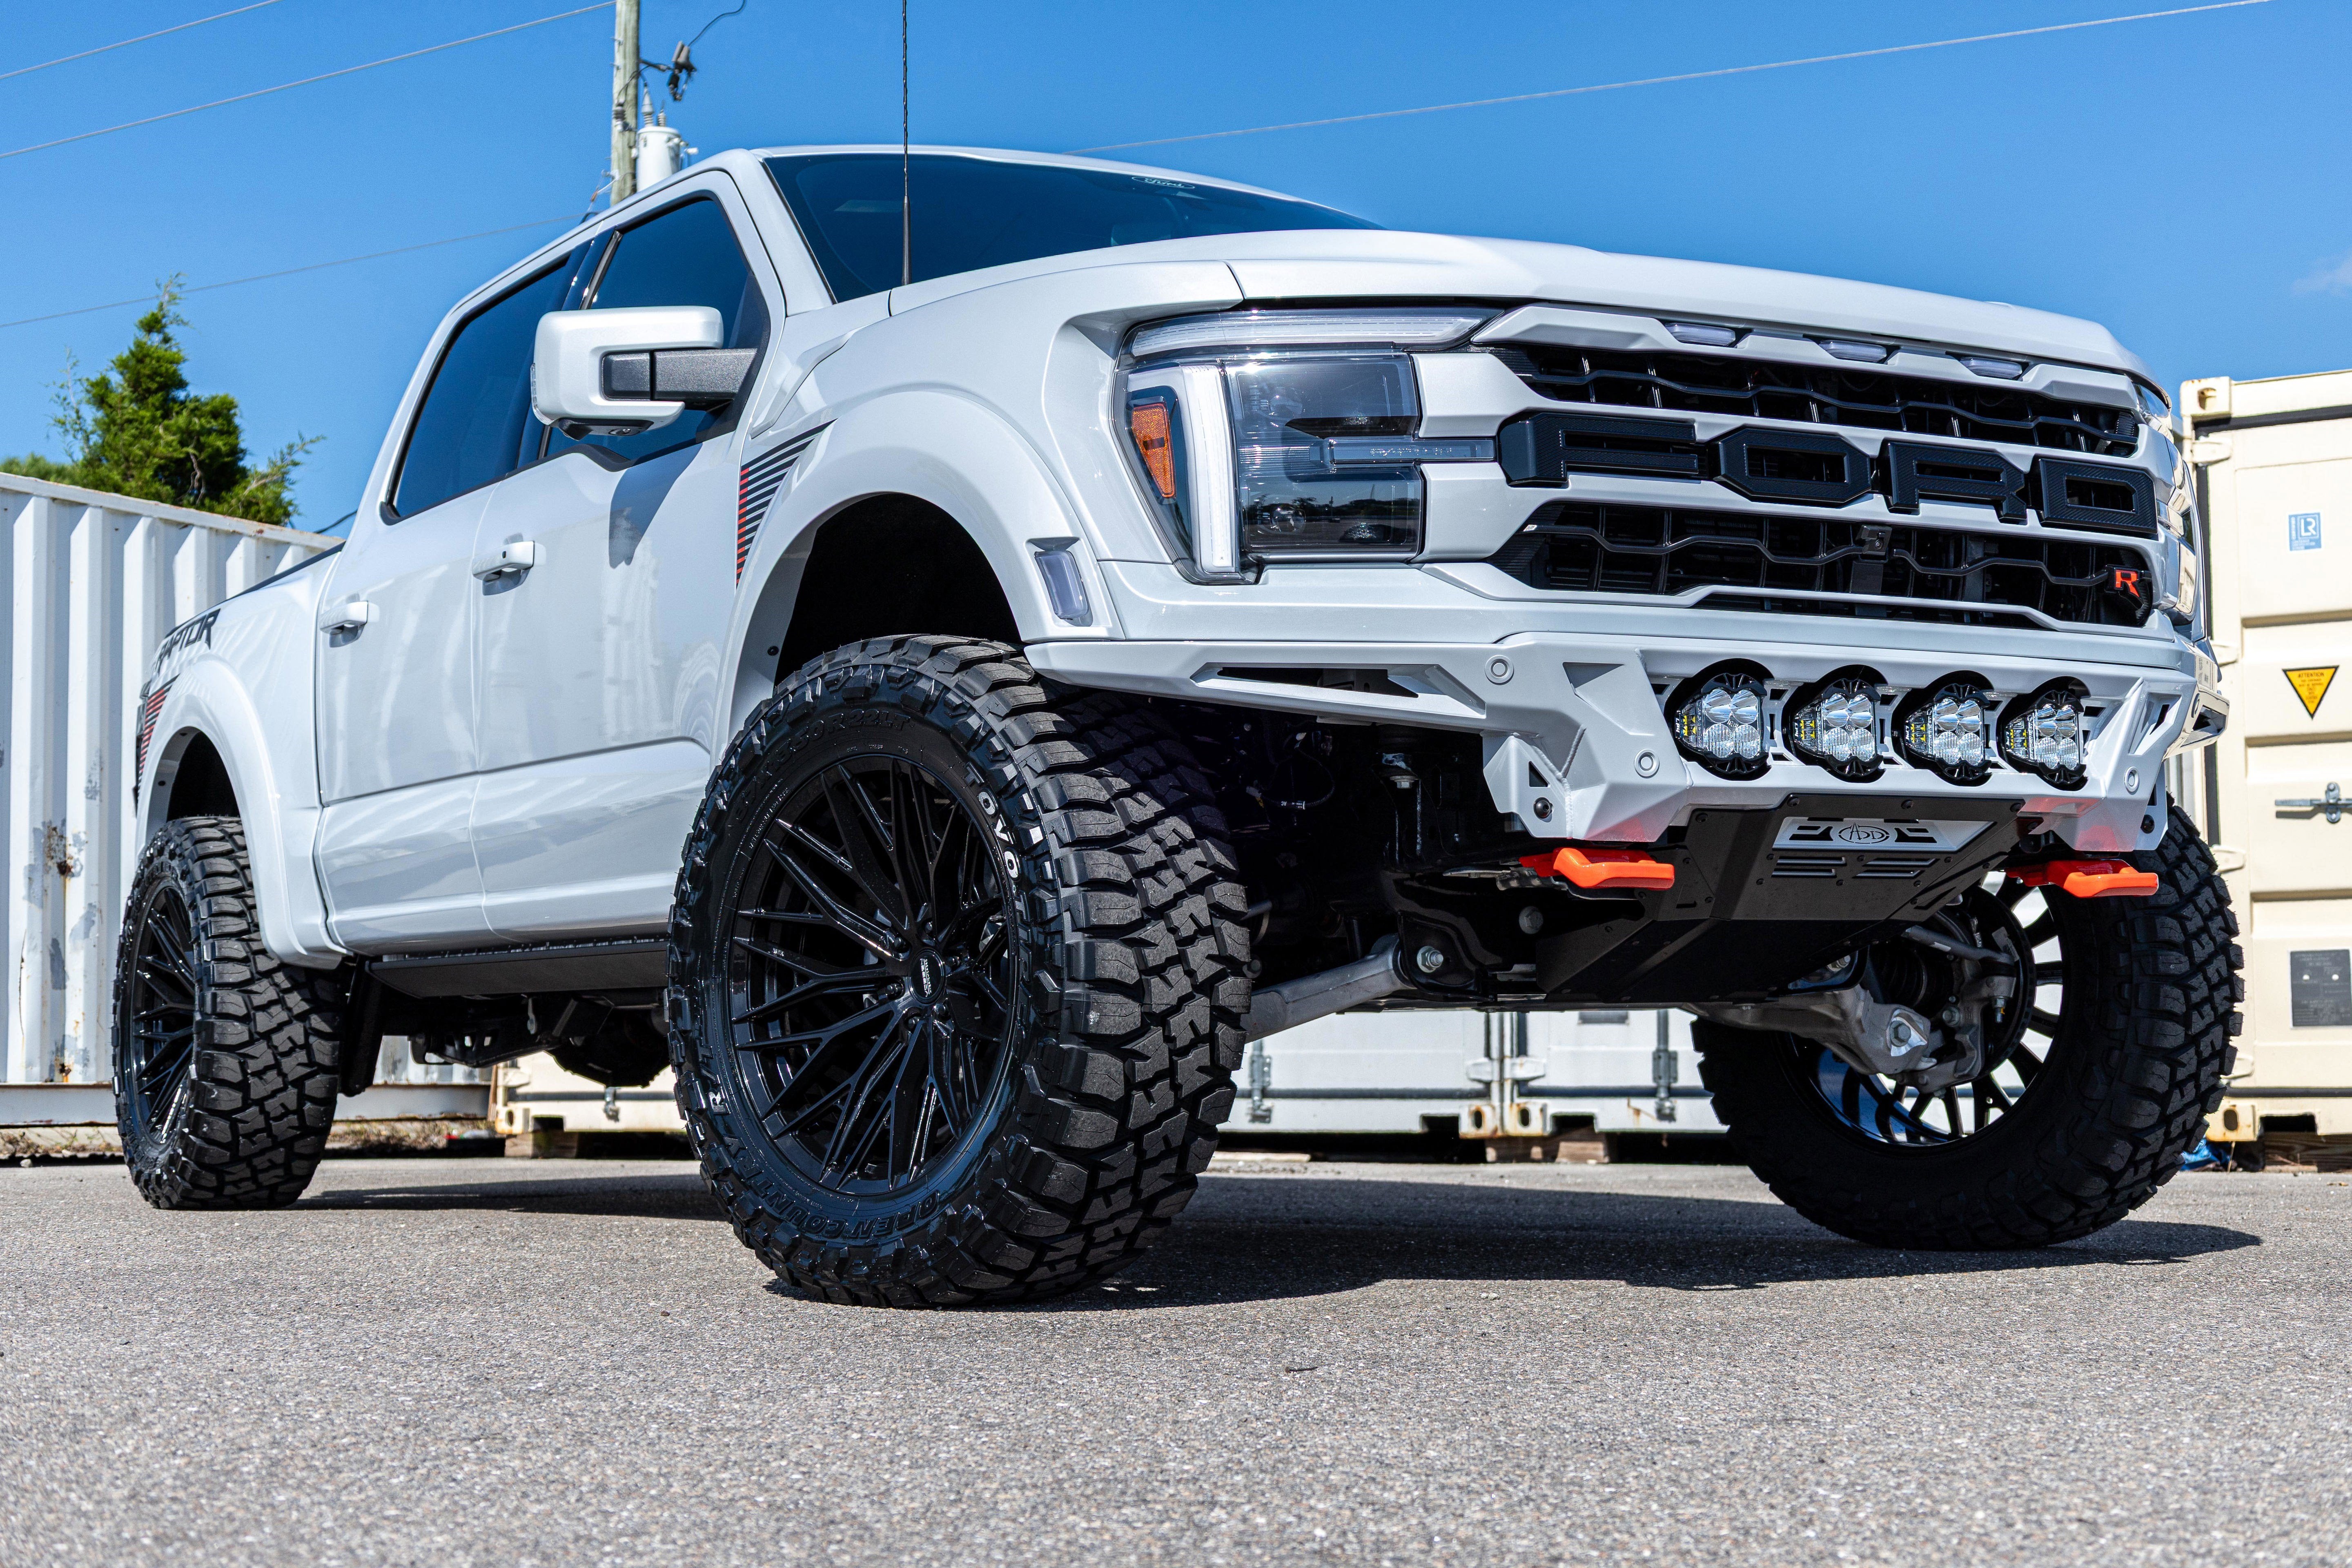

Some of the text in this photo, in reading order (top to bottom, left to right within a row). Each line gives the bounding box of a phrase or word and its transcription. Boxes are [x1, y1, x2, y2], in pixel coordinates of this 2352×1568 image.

[1144, 178, 1185, 187] Ford
[1500, 412, 2158, 536] FORD
[2301, 518, 2316, 537] LR
[2115, 569, 2140, 597] R
[155, 608, 221, 676] RAPTOR
[964, 762, 1022, 881] TOYO
[697, 1038, 731, 1114] R/T
[723, 1134, 848, 1238] COUNTRY
[851, 1189, 940, 1238] OPEN
